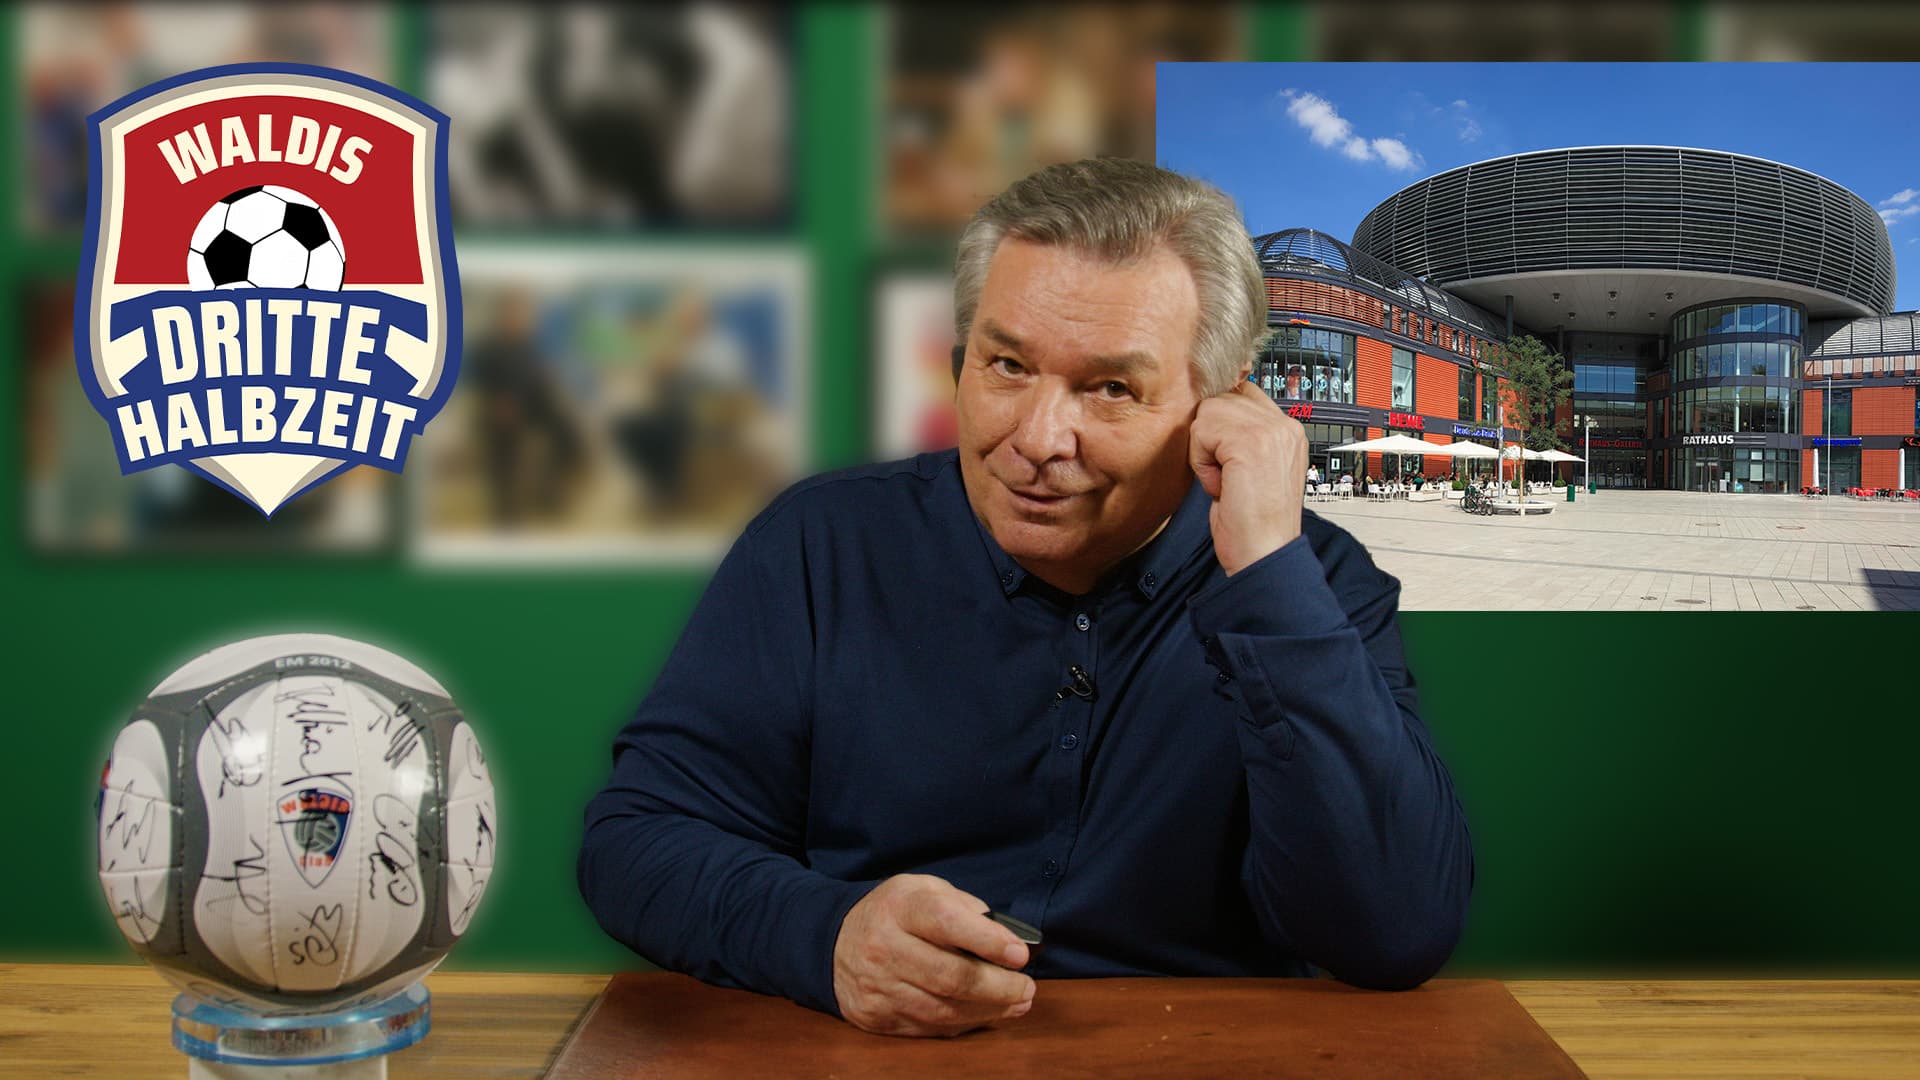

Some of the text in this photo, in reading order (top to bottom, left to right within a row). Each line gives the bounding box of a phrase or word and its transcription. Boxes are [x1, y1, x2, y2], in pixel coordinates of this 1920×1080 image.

[1389, 412, 1425, 430] REWE
[1577, 438, 1643, 449] RTHAUS-GALERIE
[1682, 434, 1735, 446] RATHAUS
[275, 655, 352, 672] EM 2012
